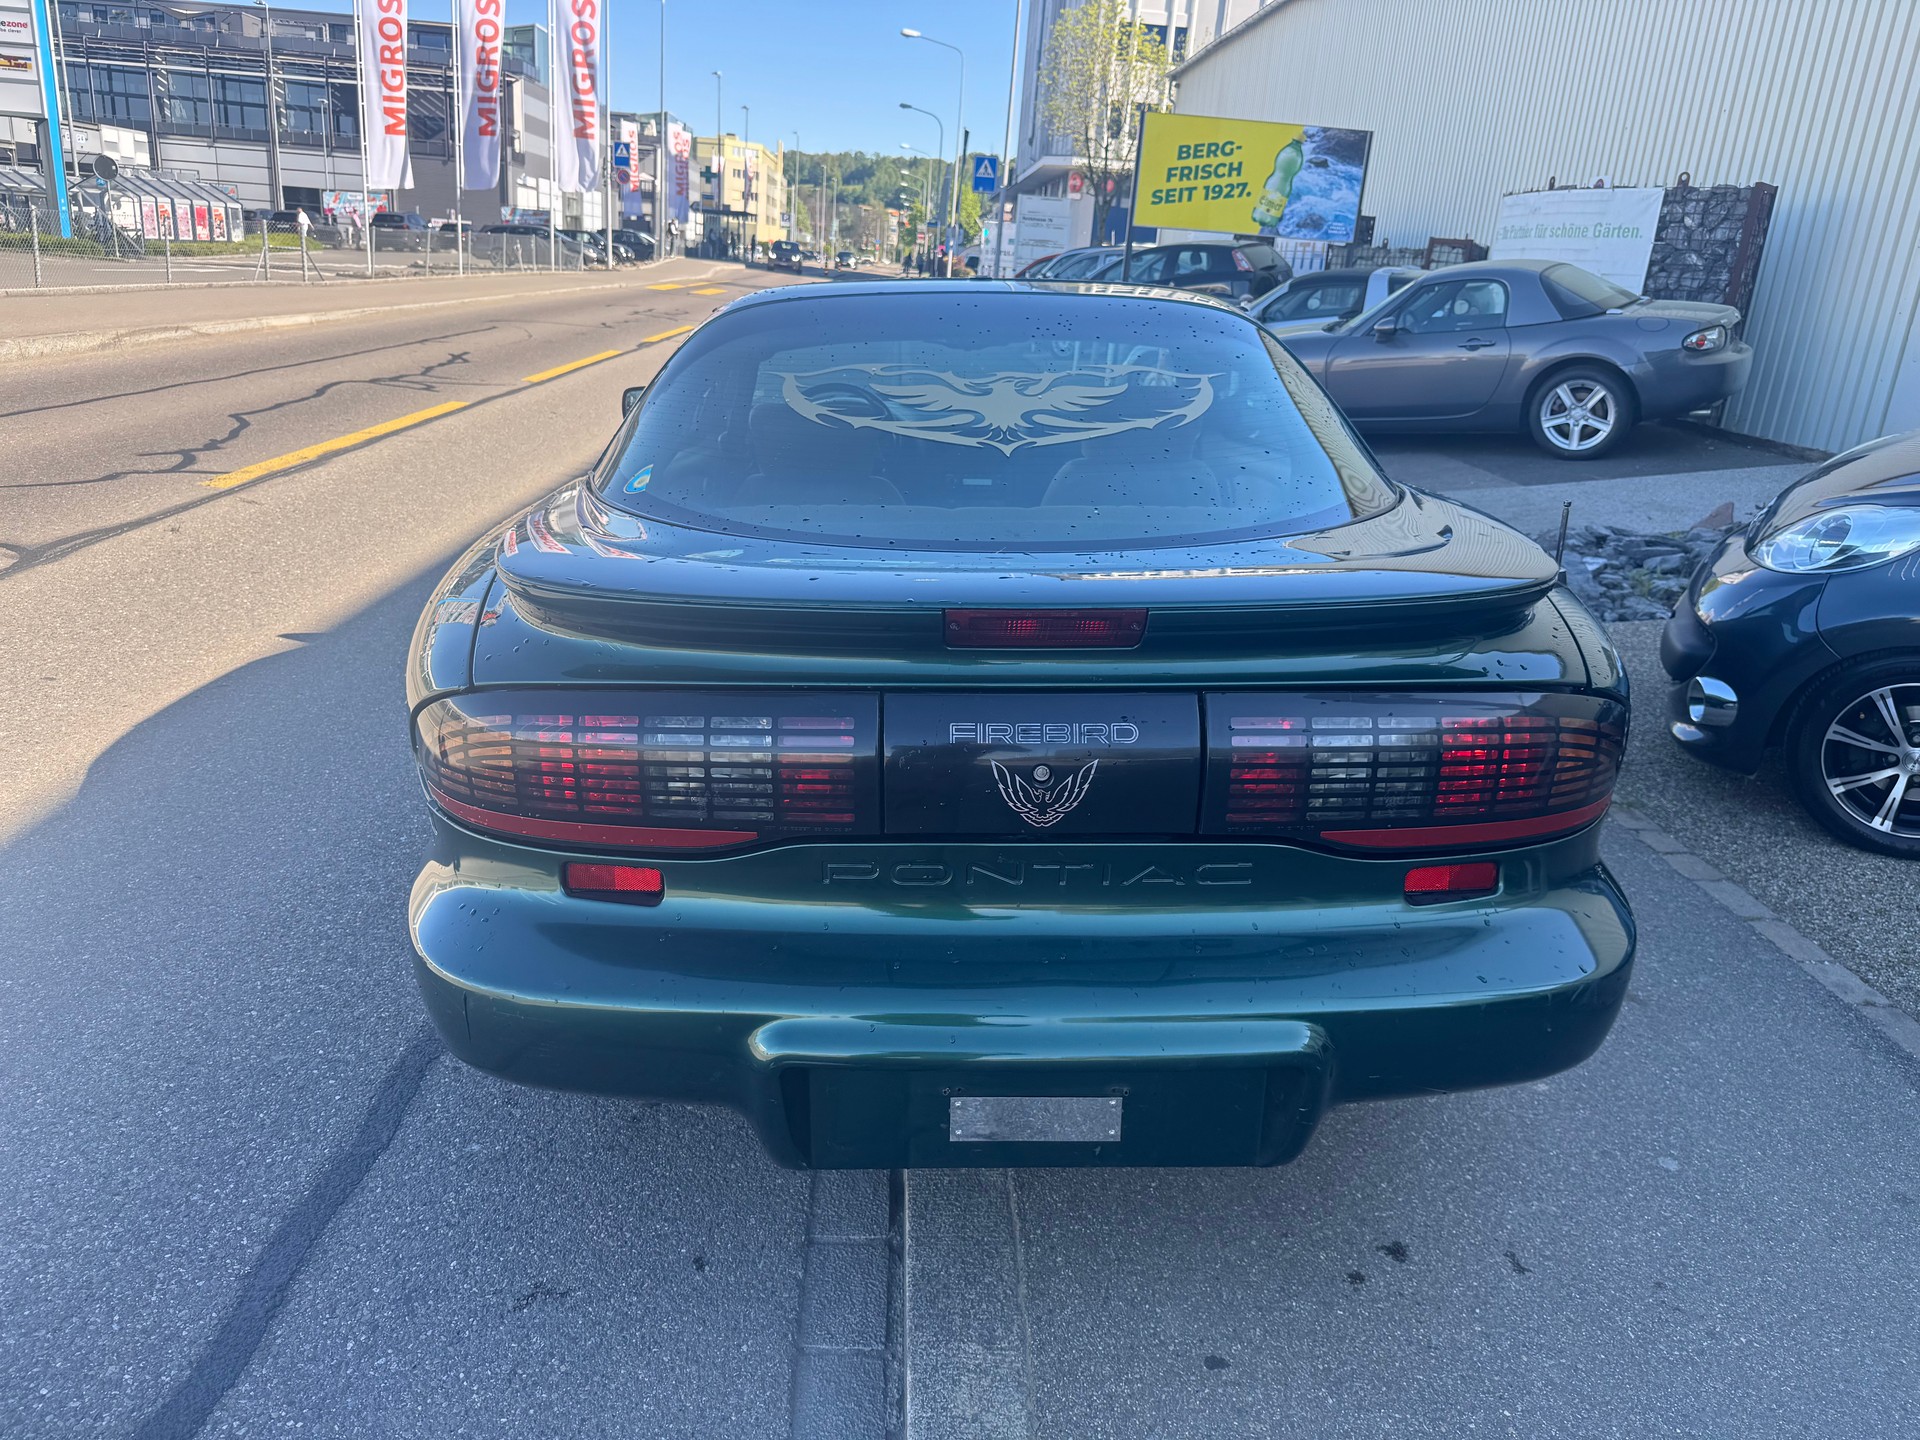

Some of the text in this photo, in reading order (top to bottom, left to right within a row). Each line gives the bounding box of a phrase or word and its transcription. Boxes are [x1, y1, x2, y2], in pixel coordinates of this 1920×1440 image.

[378, 0, 406, 135] MIGROS
[475, 0, 501, 136] MIGROS
[571, 0, 597, 139] MIGROS
[1177, 140, 1243, 161] BERG-
[673, 131, 685, 196] MIGROS
[1166, 161, 1243, 183] FRISCH
[1151, 182, 1252, 206] SEIT 1927.
[1534, 223, 1548, 239] für
[1549, 223, 1588, 238] schöne
[1593, 222, 1643, 239] Gärten.
[949, 722, 1140, 745] FIREBIRD
[822, 859, 1253, 886] PONTIAC
